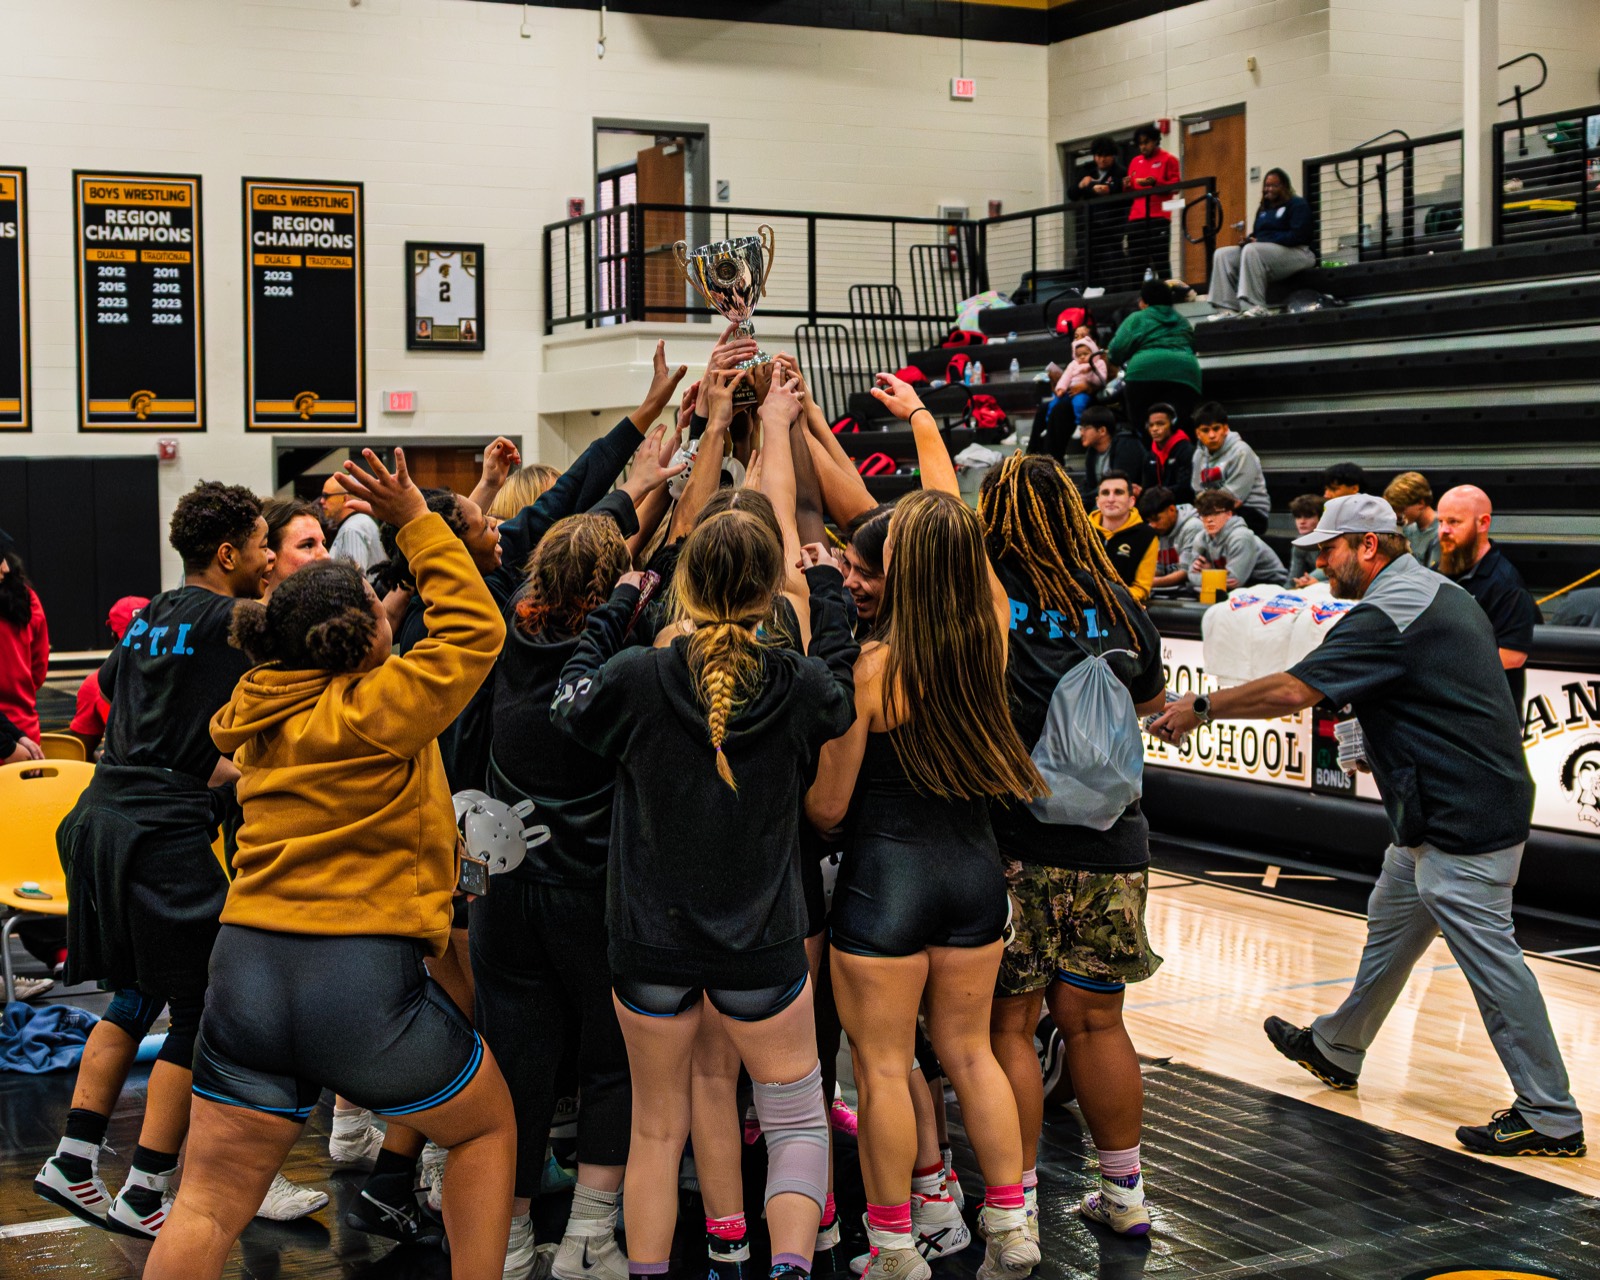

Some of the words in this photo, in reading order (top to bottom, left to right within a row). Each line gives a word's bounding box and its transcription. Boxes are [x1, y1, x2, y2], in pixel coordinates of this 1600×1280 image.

[89, 187, 119, 199] BOYS
[123, 188, 186, 202] WRESTLING
[257, 194, 287, 206] GIRLS
[290, 195, 349, 209] WRESTLING
[105, 209, 172, 226] REGION
[272, 215, 335, 232] REGION
[85, 225, 191, 243] CHAMPIONS
[253, 231, 353, 249] CHAMPIONS
[97, 250, 126, 259] DUALS
[144, 251, 188, 261] TRADITIONAL
[264, 255, 292, 265] DUALS
[308, 256, 350, 267] TRADITIONAL
[97, 266, 126, 277] 2012
[153, 267, 179, 278] 2011
[263, 270, 293, 281] 2023
[98, 281, 127, 292] 2015
[152, 283, 181, 294] 2012
[263, 285, 294, 296] 2024
[439, 281, 451, 302] 2
[97, 297, 128, 308] 2023
[152, 298, 182, 309] 2023
[97, 312, 129, 323] 2024
[152, 313, 183, 324] 2024
[122, 618, 195, 656] P.T.I.
[1316, 768, 1352, 789] BONUS
